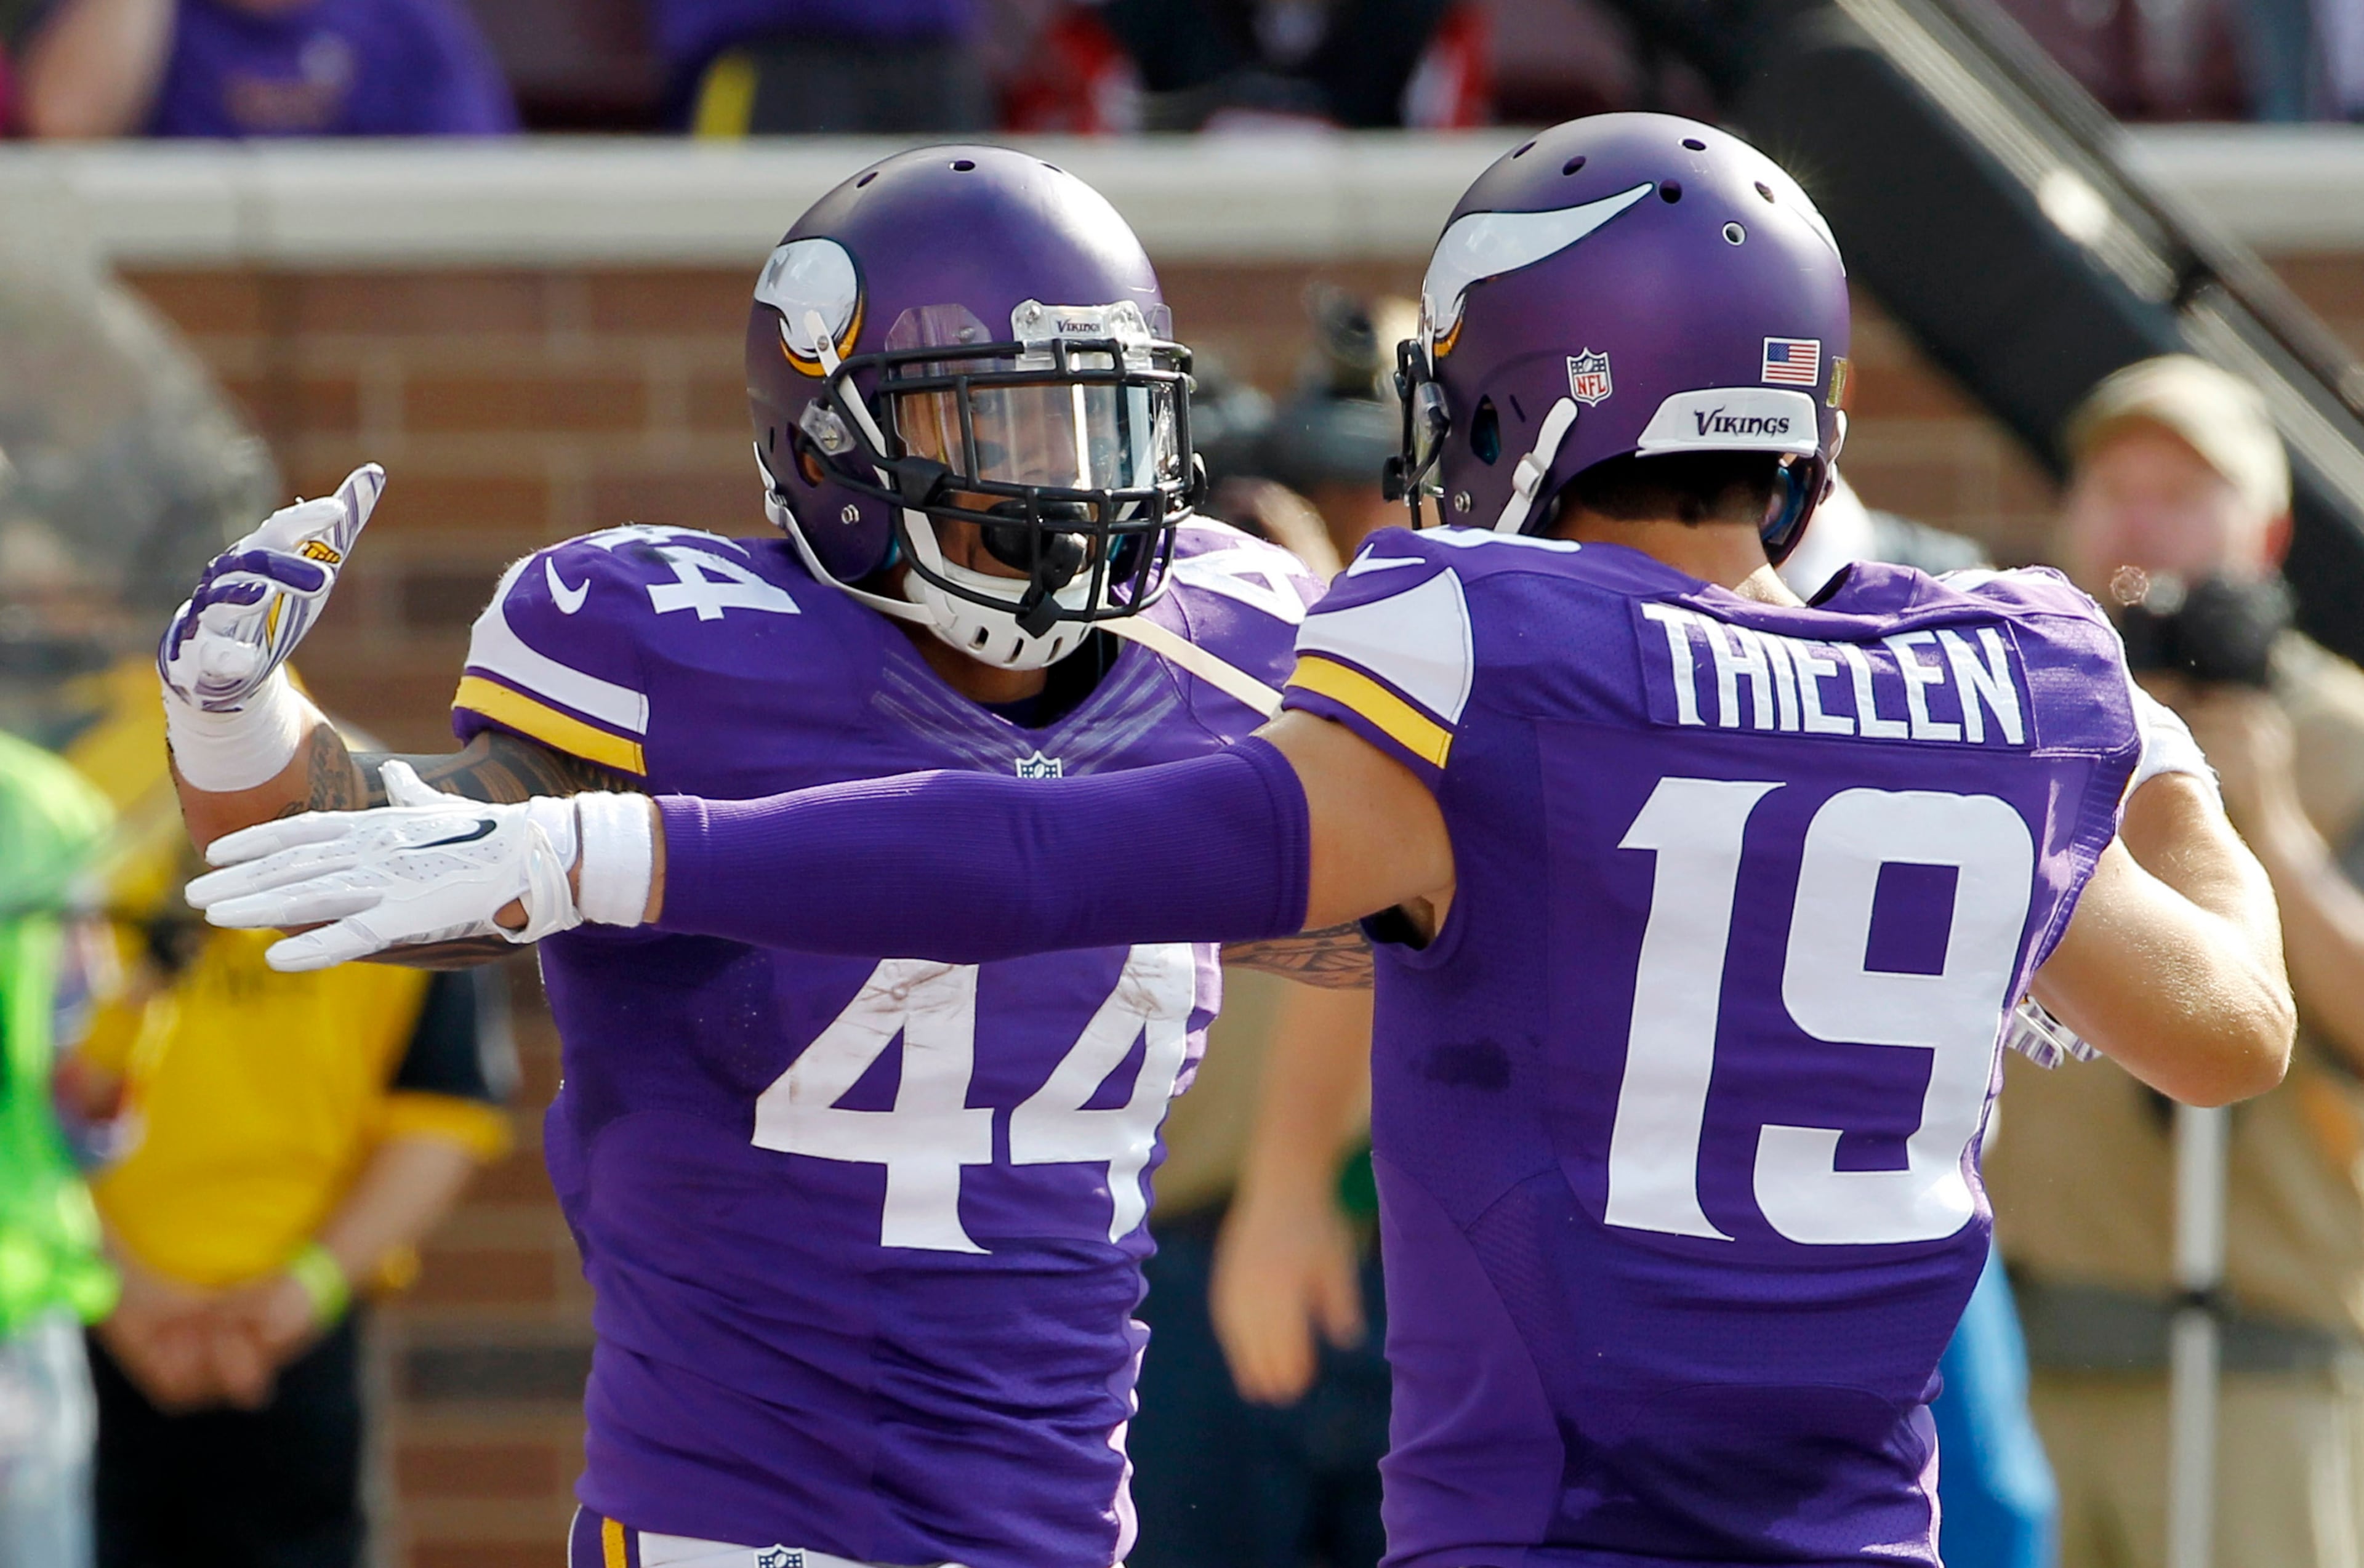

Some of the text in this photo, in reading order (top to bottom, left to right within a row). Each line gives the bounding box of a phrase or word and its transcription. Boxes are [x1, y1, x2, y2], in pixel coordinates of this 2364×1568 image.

[1575, 374, 1606, 397] NFL
[1641, 602, 2025, 746] THIELEN
[750, 941, 1196, 1255] 44
[1604, 776, 2035, 1245] 19
